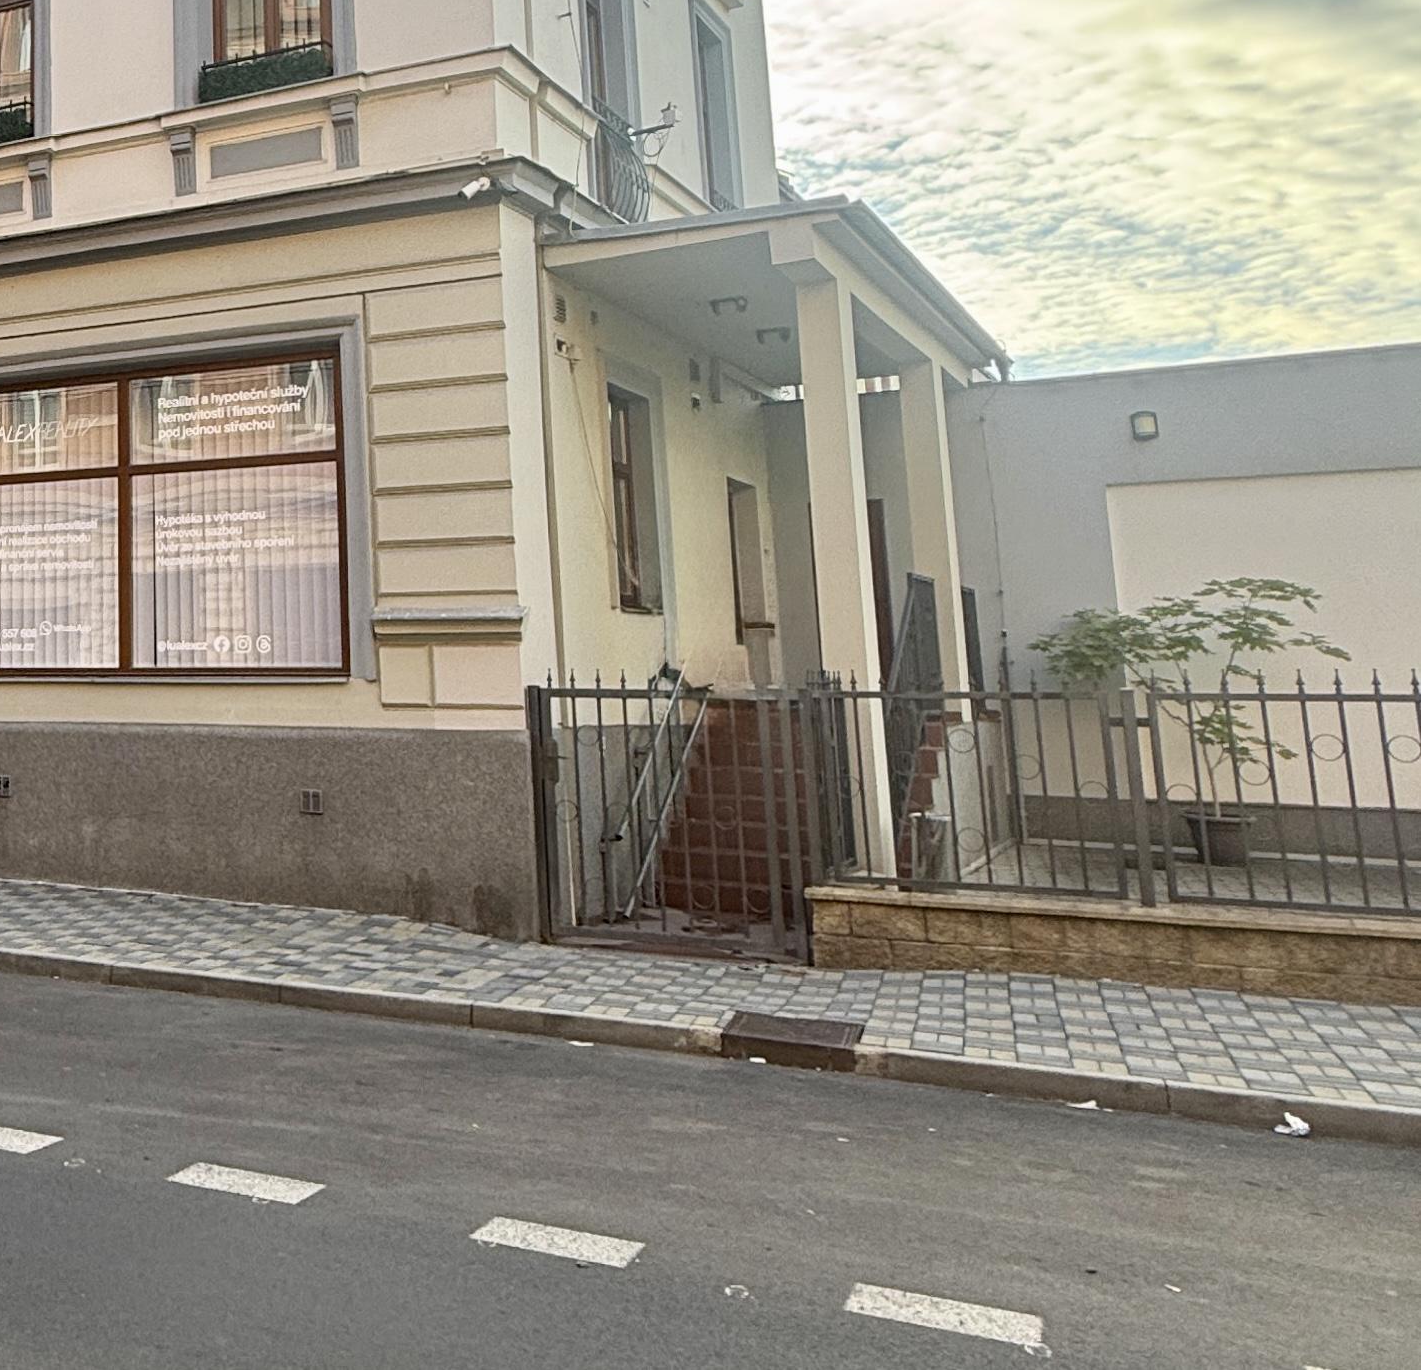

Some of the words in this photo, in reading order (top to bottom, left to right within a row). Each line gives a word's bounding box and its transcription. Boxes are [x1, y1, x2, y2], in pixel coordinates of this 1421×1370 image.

[211, 388, 267, 406] hypoteční
[271, 384, 309, 399] služby
[158, 408, 224, 423] Nemovitosti
[233, 399, 300, 416] financování
[159, 427, 180, 441] pod
[182, 425, 221, 439] jednou
[224, 419, 275, 433] střechou
[205, 526, 242, 536] sazbou
